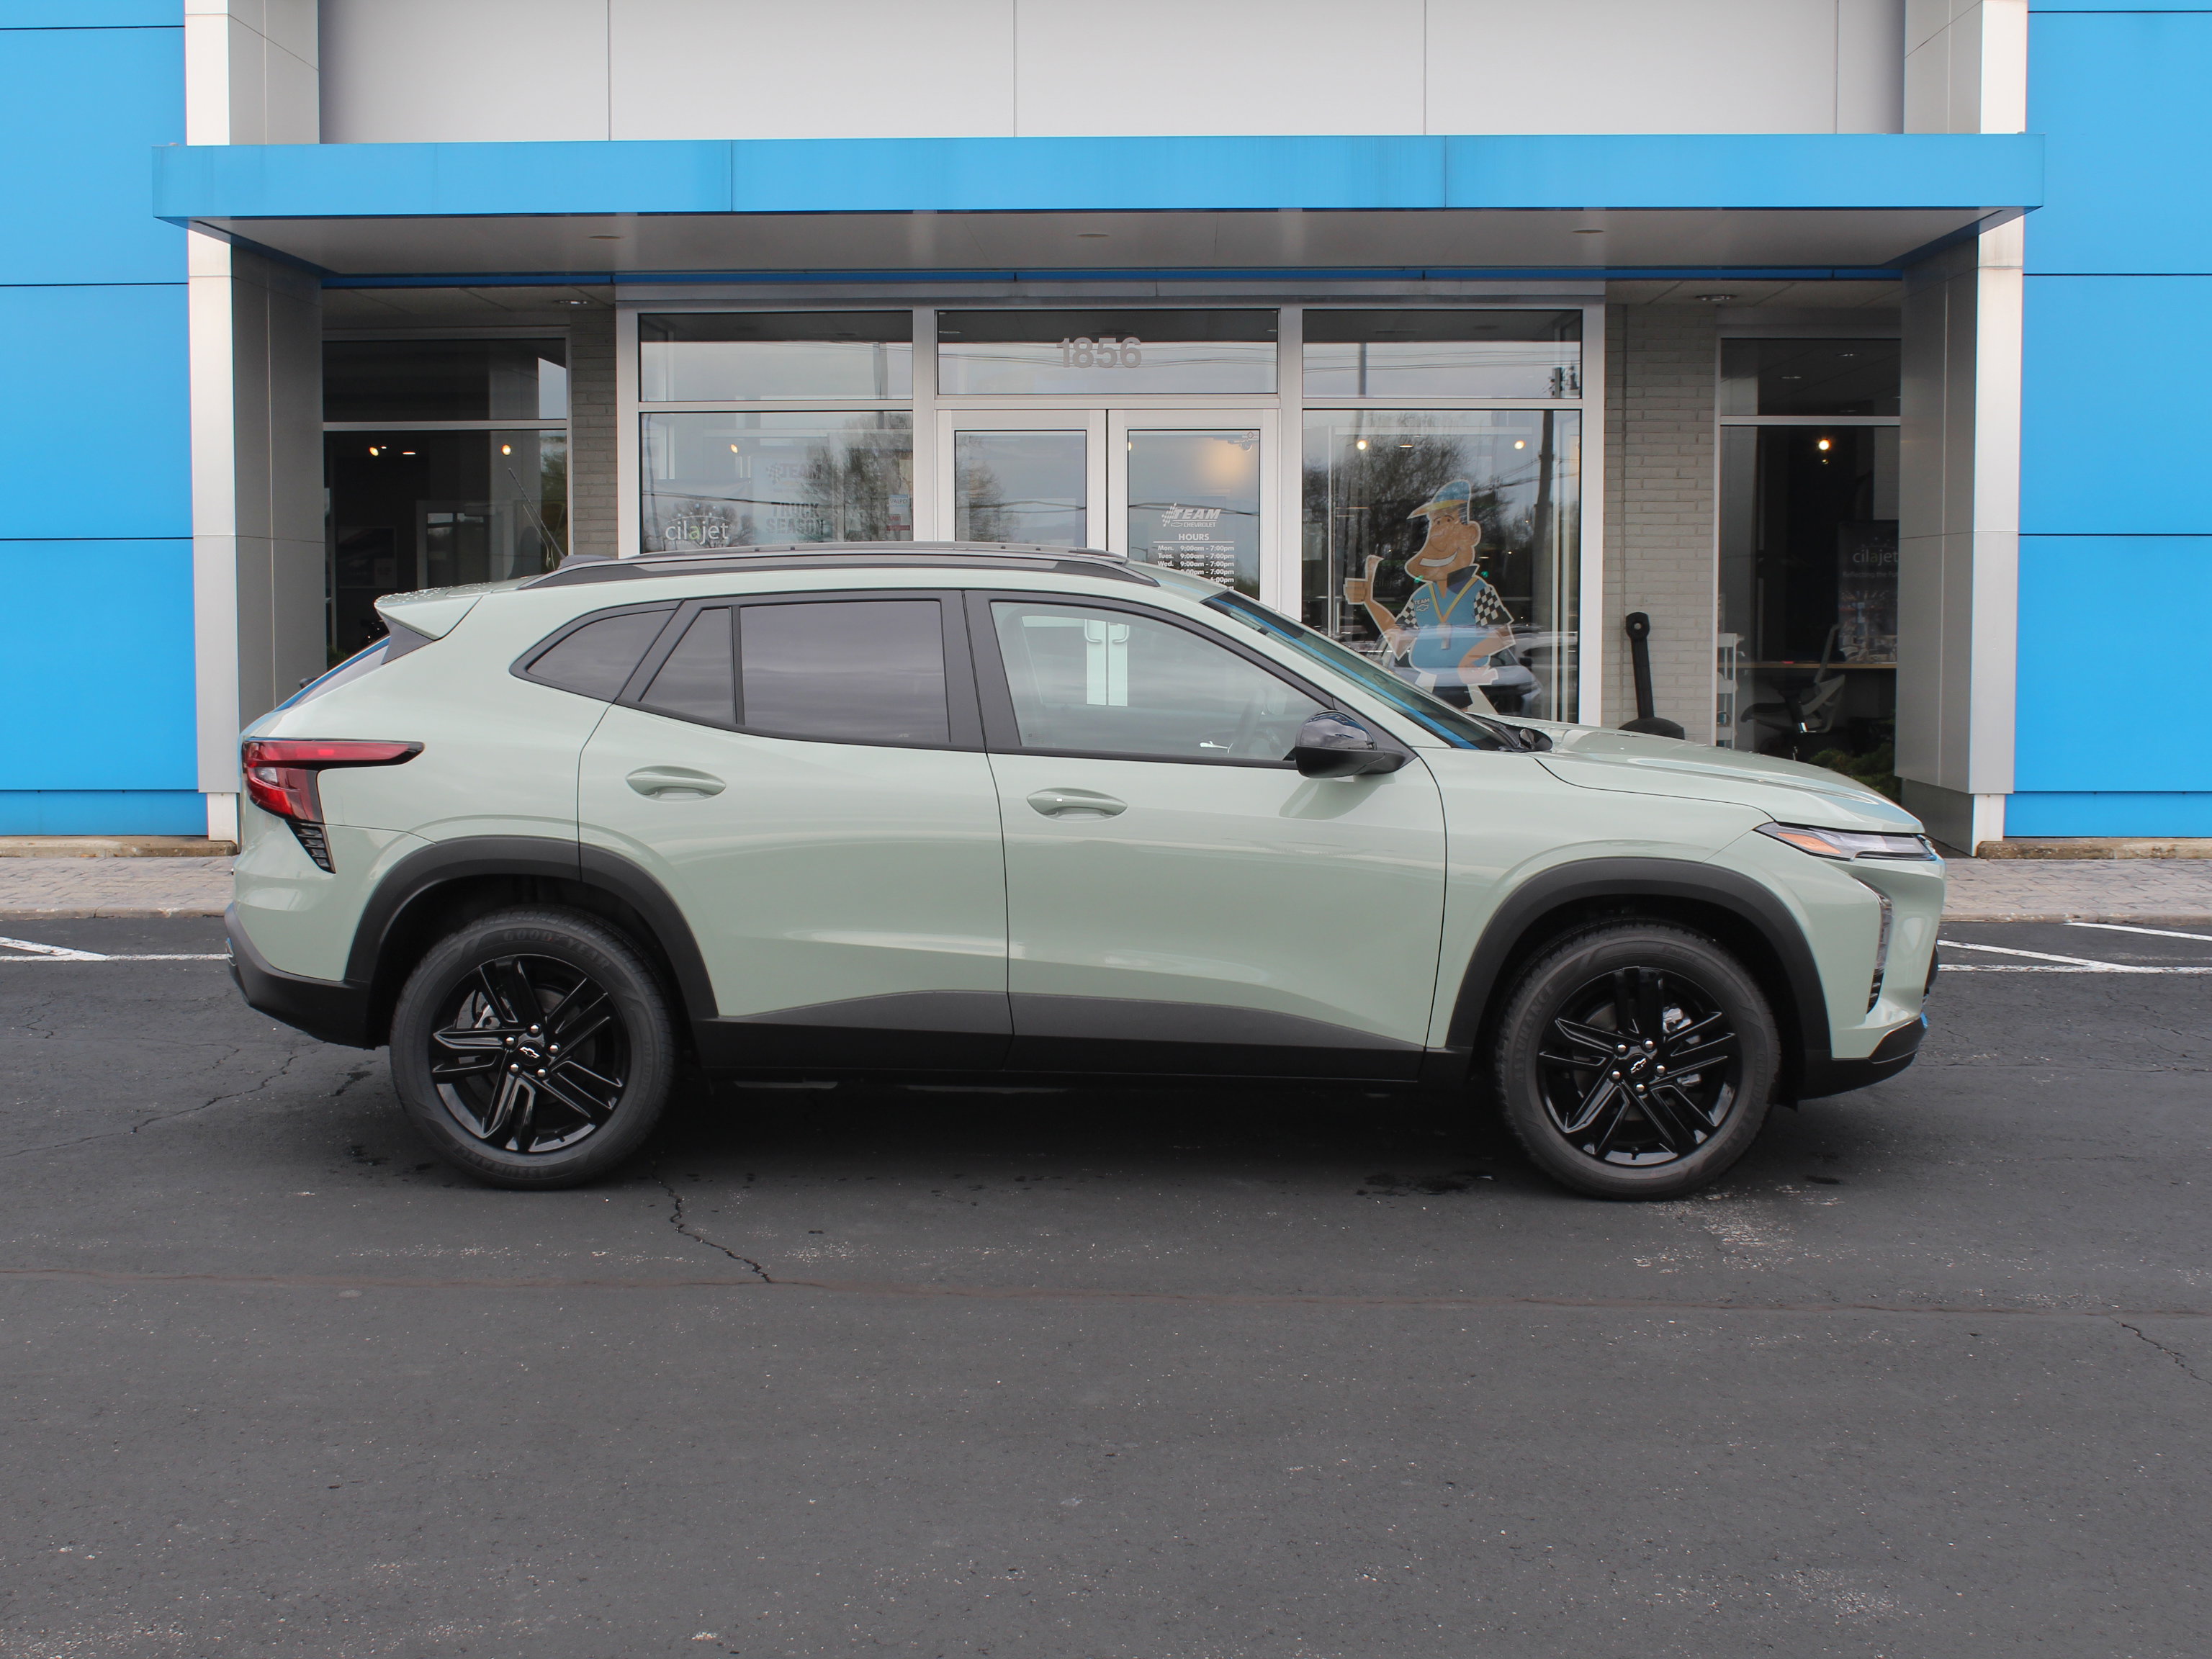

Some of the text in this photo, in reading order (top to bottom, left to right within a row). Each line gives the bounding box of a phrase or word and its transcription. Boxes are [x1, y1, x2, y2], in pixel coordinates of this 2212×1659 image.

[1056, 337, 1142, 369] 1856
[1172, 508, 1221, 519] TEAM
[665, 519, 729, 545] cilajet
[766, 518, 824, 535] SEASON
[1853, 549, 1898, 566] cilajet
